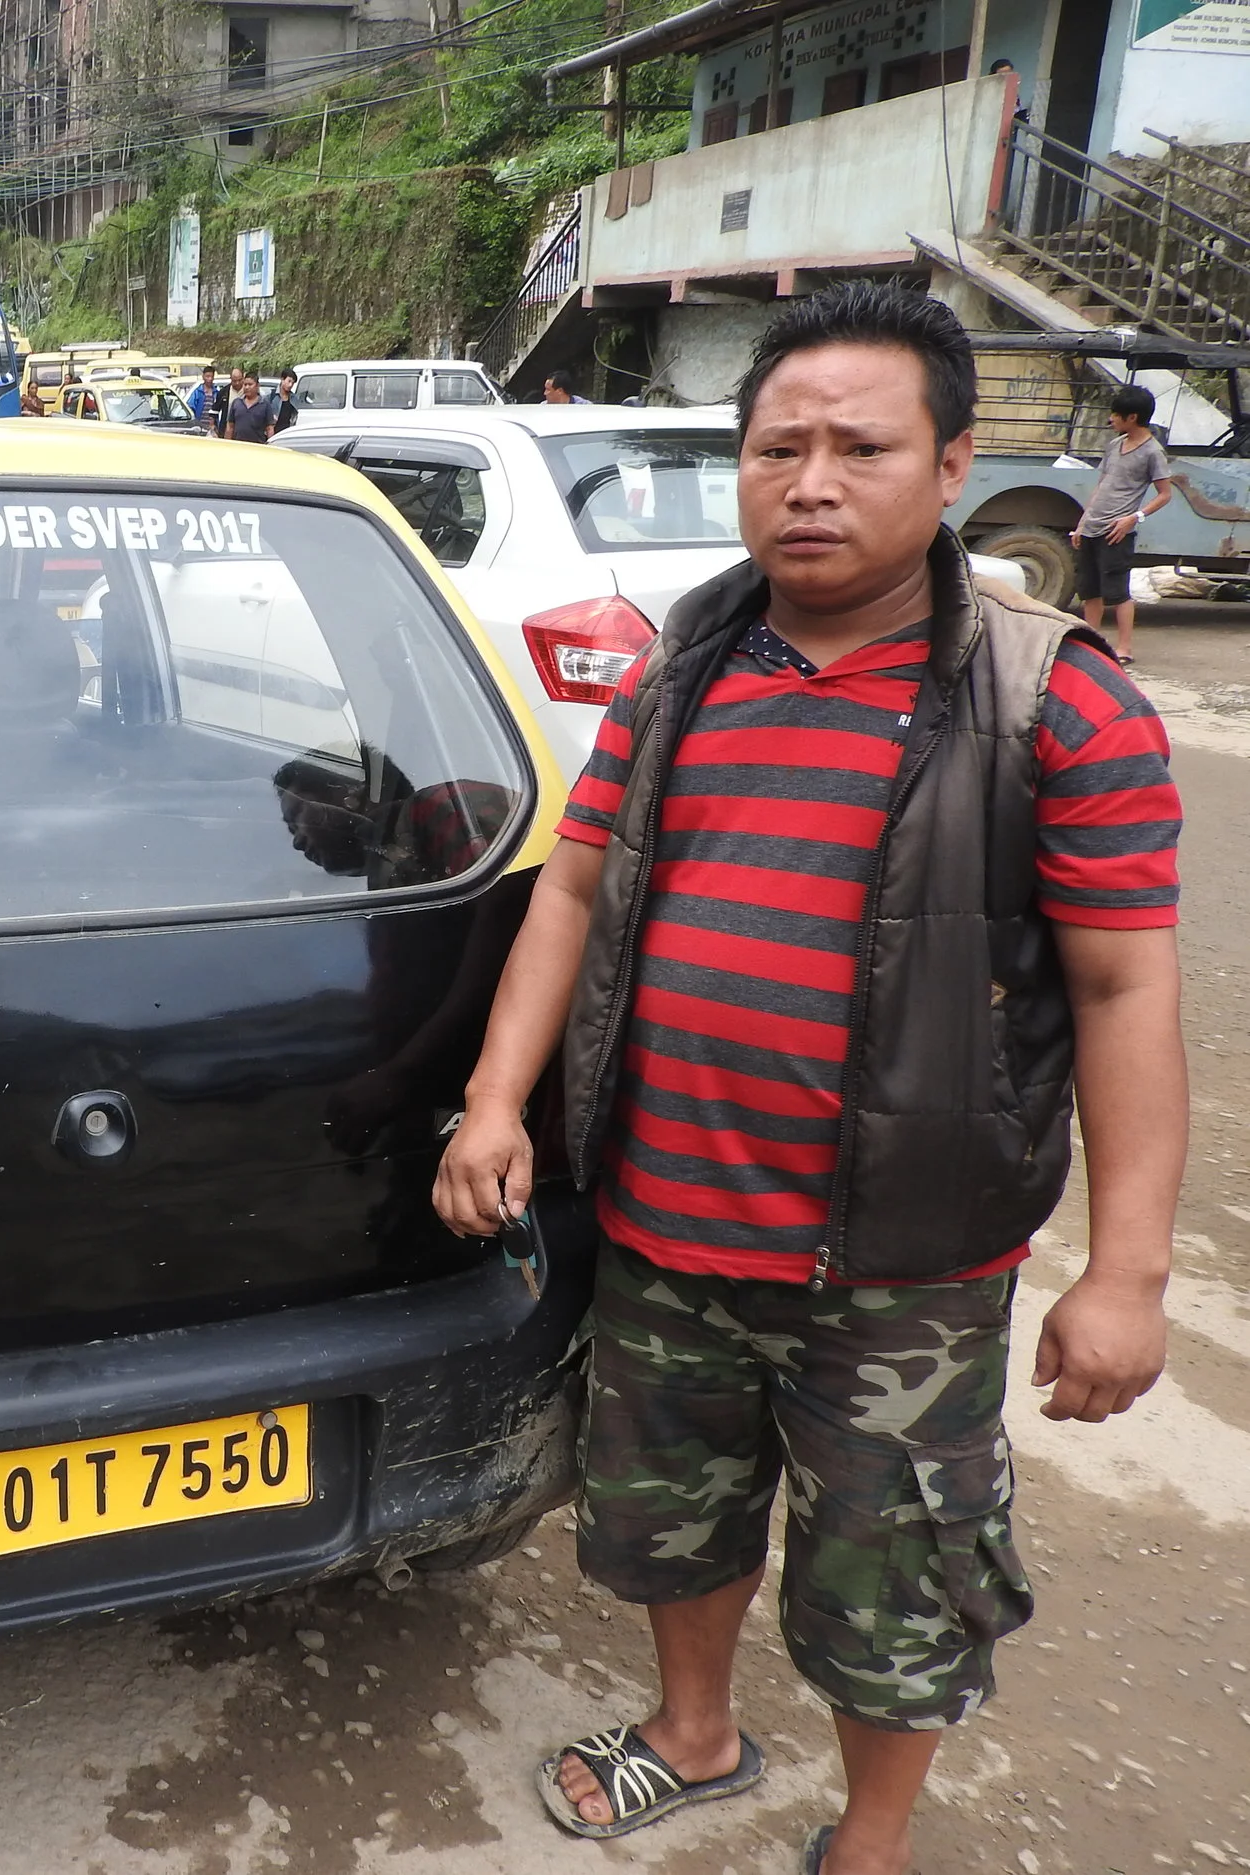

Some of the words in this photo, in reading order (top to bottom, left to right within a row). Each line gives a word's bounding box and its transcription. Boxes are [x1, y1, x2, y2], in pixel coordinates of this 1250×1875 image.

[744, 30, 806, 61] KOHMA
[810, 4, 890, 39] MUNICIPAL
[69, 505, 168, 550] SVEP
[178, 510, 262, 554] 2017
[141, 1424, 289, 1507] 7550
